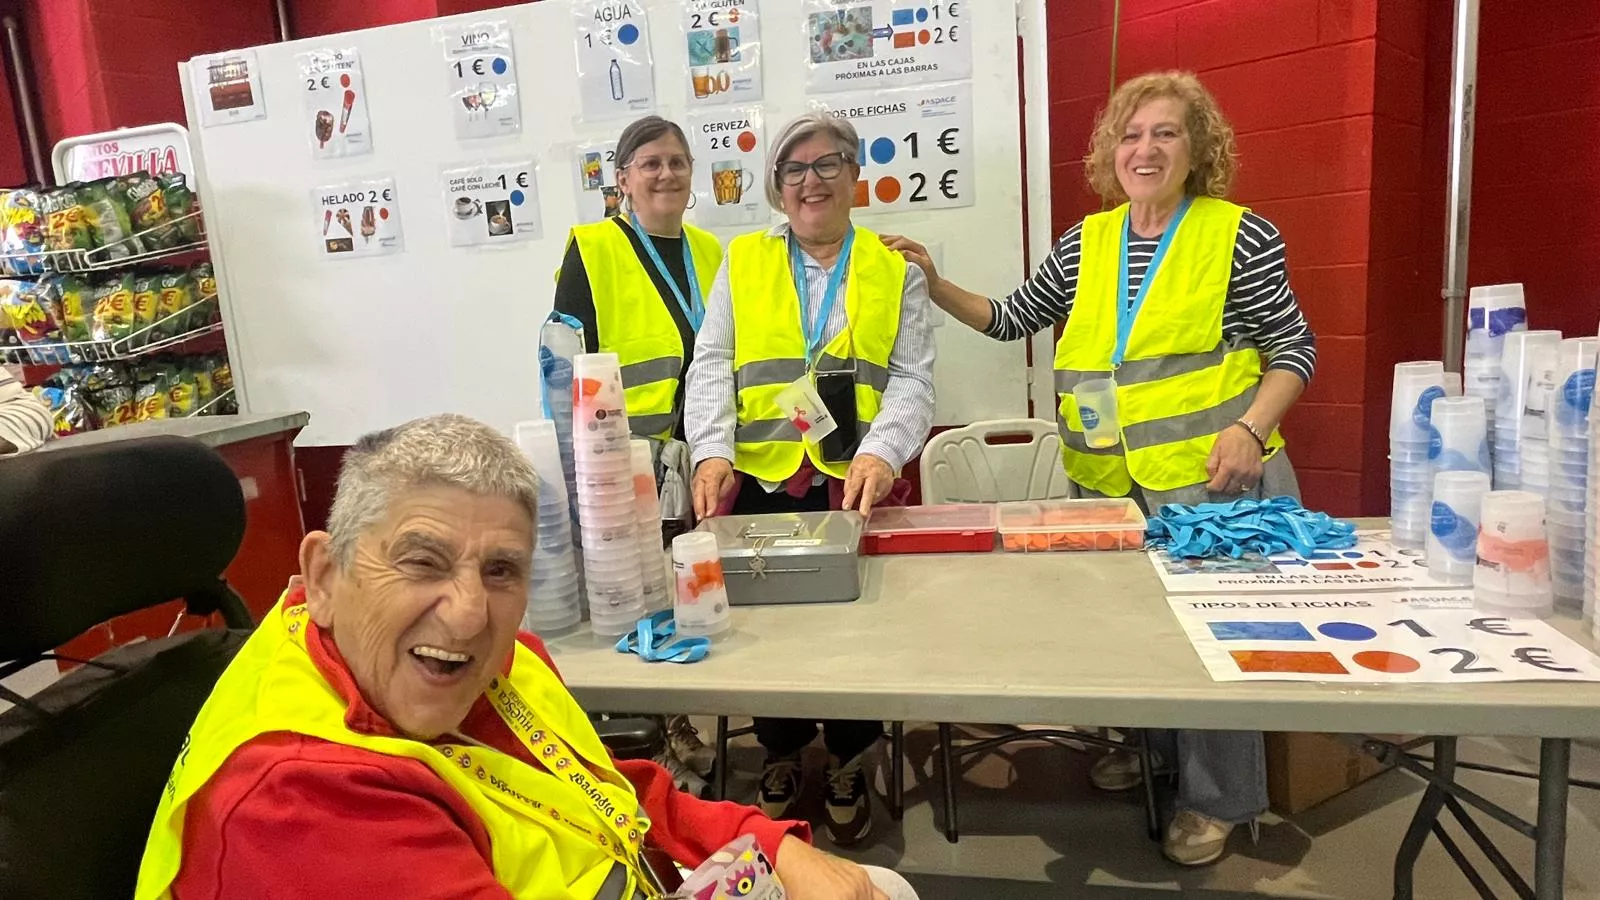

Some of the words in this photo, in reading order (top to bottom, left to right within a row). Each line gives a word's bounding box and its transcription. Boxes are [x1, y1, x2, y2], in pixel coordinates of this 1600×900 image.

[594, 4, 632, 22] AGUA
[932, 5, 939, 19] 1
[949, 3, 959, 17] €
[691, 14, 702, 29] 2
[708, 12, 719, 26] €
[584, 33, 592, 48] 1
[934, 27, 943, 44] 2
[949, 26, 958, 42] €
[453, 61, 463, 78] 1
[472, 59, 485, 75] €
[870, 60, 886, 68] LAS
[888, 57, 915, 66] CAJAS
[886, 67, 902, 75] LAS
[904, 64, 938, 73] BARRAS
[307, 79, 317, 91] 2
[320, 76, 330, 89] €
[850, 108, 864, 117] DE
[867, 103, 906, 115] FICHAS
[703, 119, 751, 133] CERVEZA
[710, 138, 719, 150] 2
[722, 136, 731, 149] €
[903, 132, 919, 158] 1
[937, 128, 960, 155] €
[606, 151, 615, 162] 2
[482, 181, 501, 189] LECHE
[498, 174, 506, 190] 1
[516, 172, 528, 188] €
[909, 173, 928, 203] 2
[939, 169, 959, 199] €
[322, 192, 364, 205] HELADO
[369, 190, 378, 203] 2
[382, 189, 392, 201] €
[1384, 560, 1409, 568] 2
[1387, 619, 1437, 637] 1
[1466, 617, 1533, 636] €
[1429, 648, 1502, 674] 2
[1510, 647, 1583, 673] €
